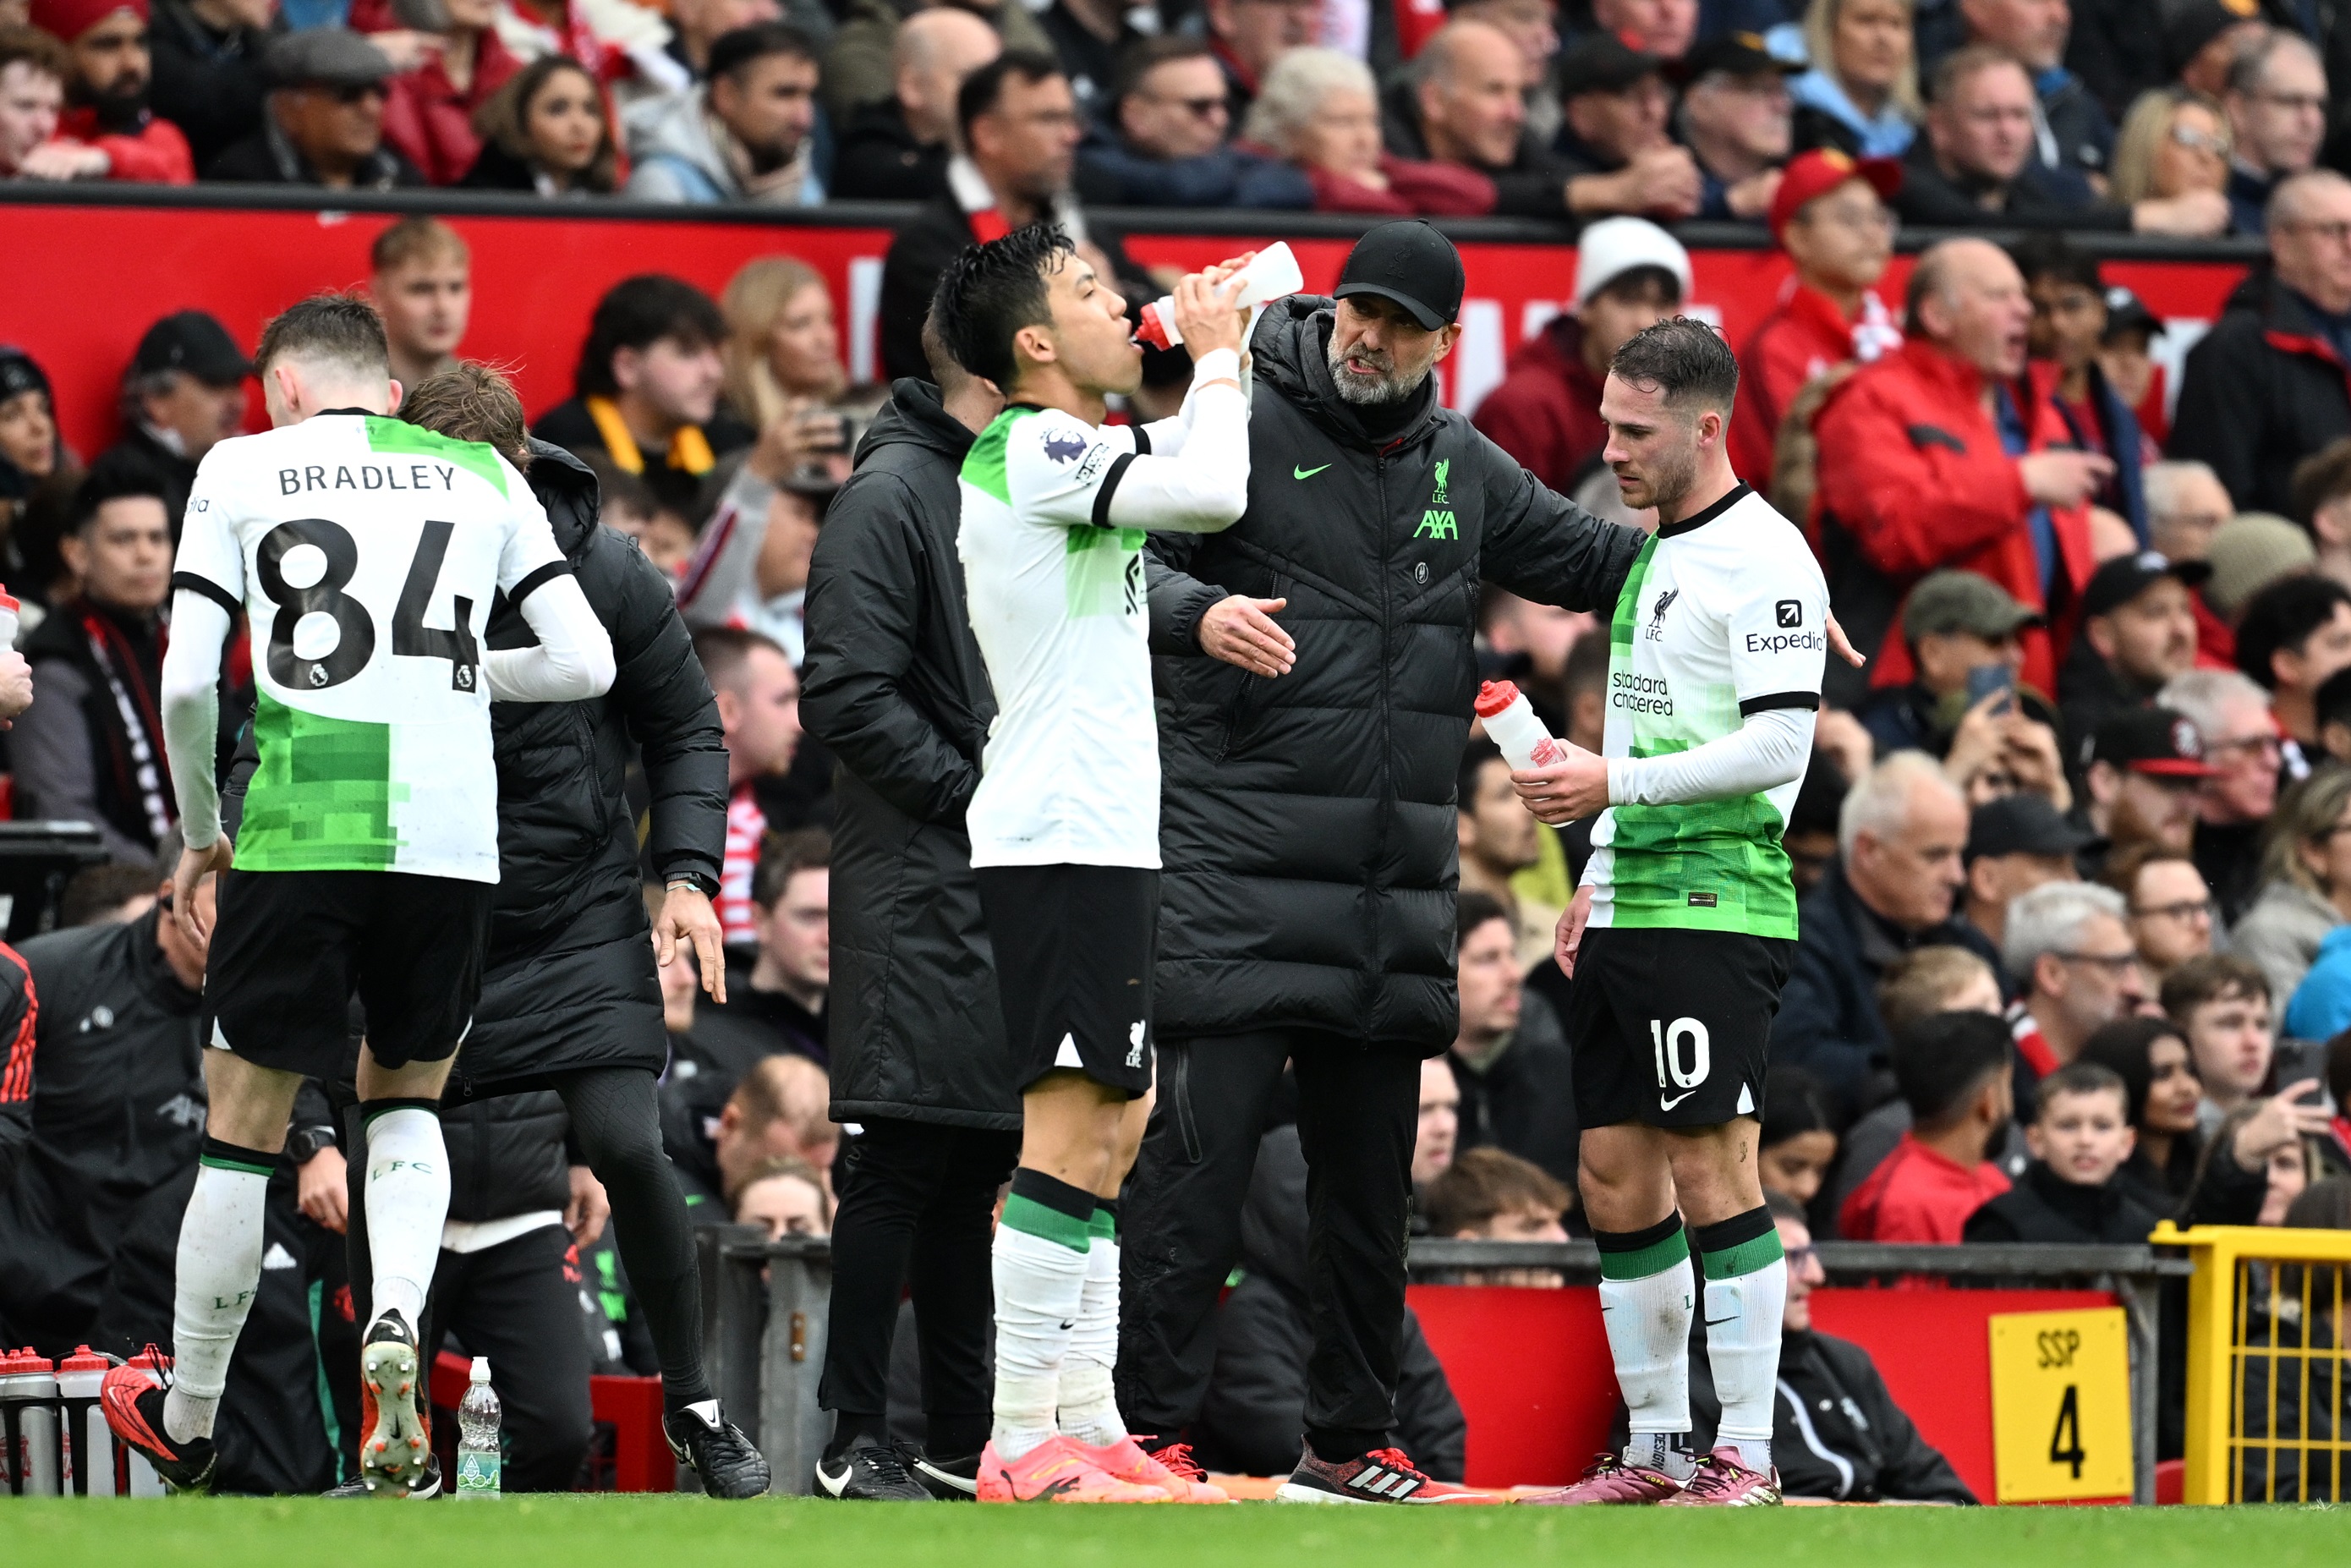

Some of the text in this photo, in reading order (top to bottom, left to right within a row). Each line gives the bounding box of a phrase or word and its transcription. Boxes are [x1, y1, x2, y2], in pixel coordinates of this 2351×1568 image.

[279, 465, 454, 496] BRADLEY
[1412, 510, 1459, 540] AXA
[256, 518, 480, 694] 84
[1650, 1017, 1710, 1088] 10
[2037, 1330, 2080, 1368] SSP
[2049, 1383, 2086, 1479] 4
[1646, 1475, 1665, 1486] COPA
